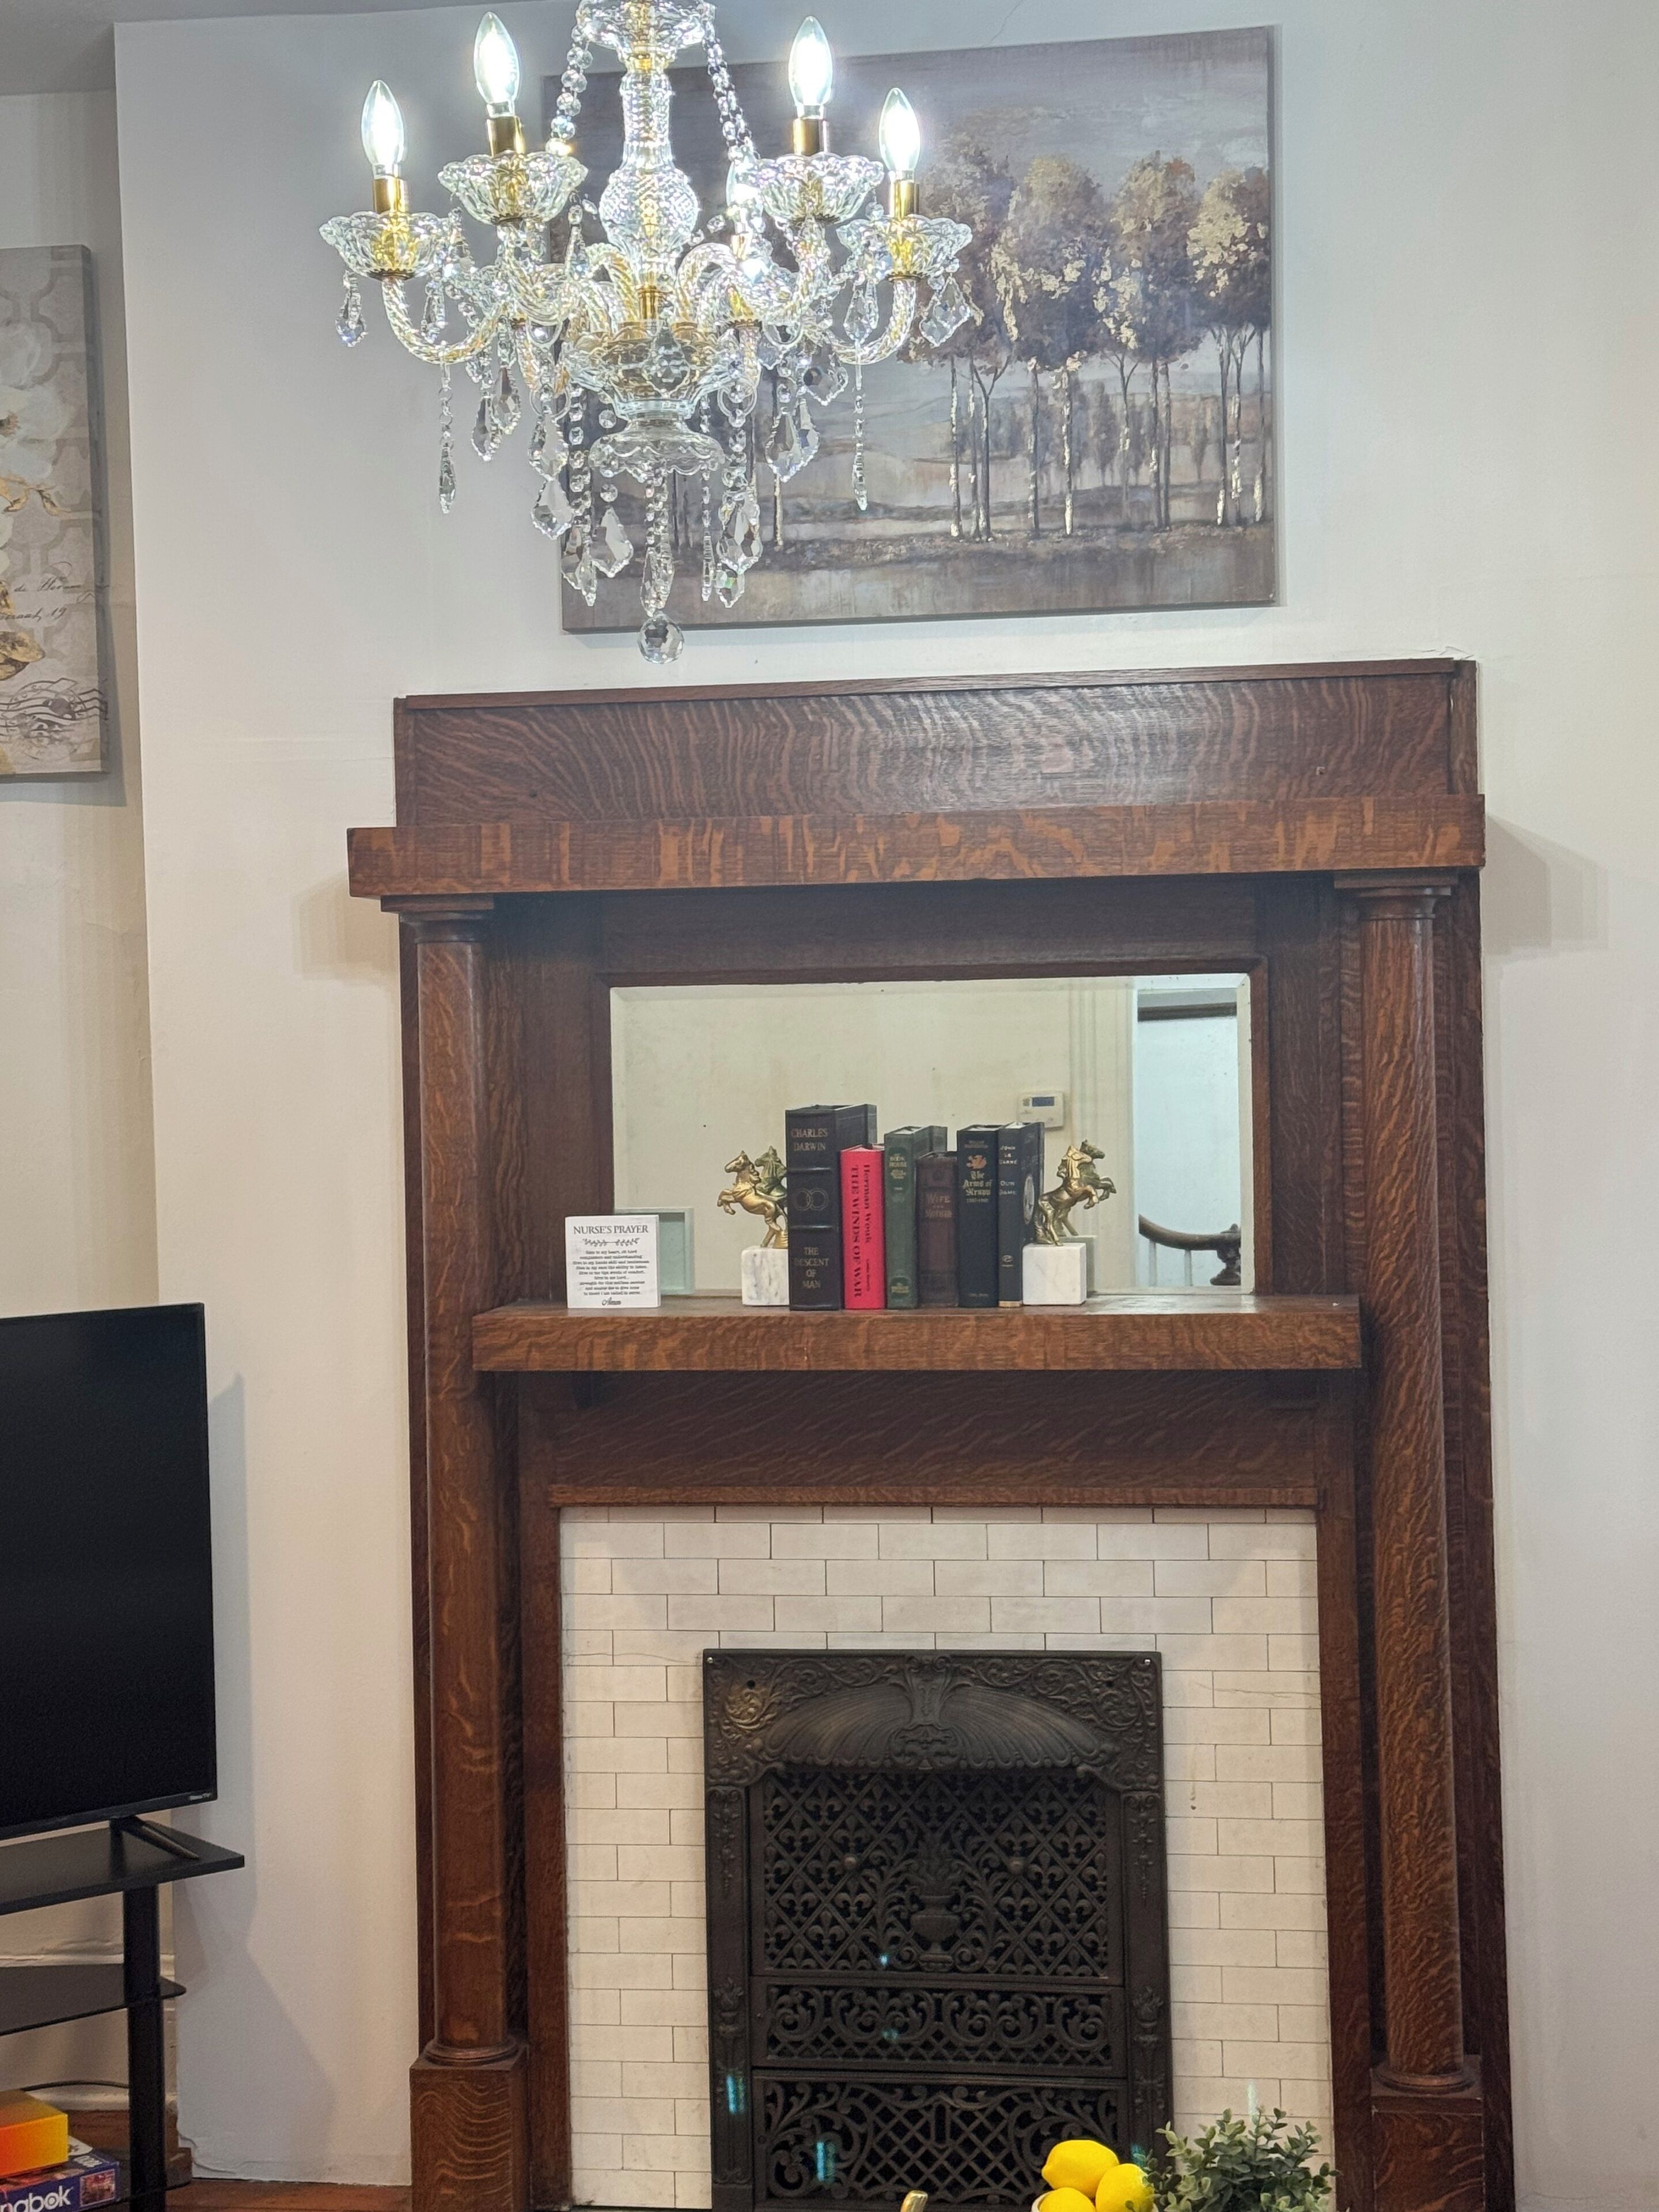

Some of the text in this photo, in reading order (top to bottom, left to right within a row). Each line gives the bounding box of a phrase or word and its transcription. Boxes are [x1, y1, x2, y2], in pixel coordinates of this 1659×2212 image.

[790, 1128, 828, 1138] CHARLES
[793, 1142, 827, 1152] DARWIN
[970, 1171, 985, 1180] The
[963, 1179, 984, 1189] Arms
[573, 1225, 649, 1234] NURSE'S PRAYER
[851, 1164, 862, 1298] THE WINDS OF WAR
[803, 1247, 819, 1255] THE
